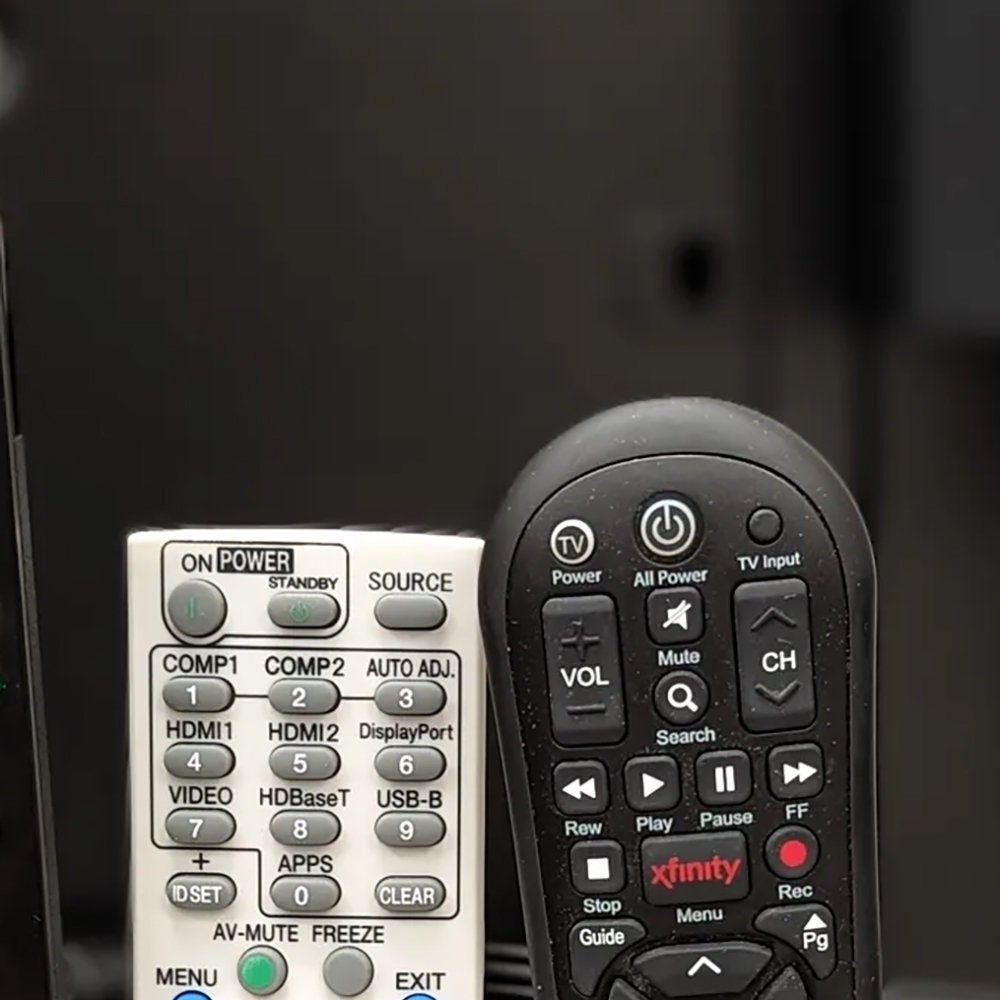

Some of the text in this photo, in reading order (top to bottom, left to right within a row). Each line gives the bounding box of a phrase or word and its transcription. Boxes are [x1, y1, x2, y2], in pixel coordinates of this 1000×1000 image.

[559, 535, 585, 554] TV
[181, 554, 212, 573] ON
[220, 550, 291, 573] POWER
[737, 553, 801, 571] TV Input
[268, 577, 338, 590] STANDBY
[368, 573, 453, 592] SOURCE
[552, 570, 602, 585] Power
[634, 568, 708, 587] All Power
[163, 654, 237, 675] COMP1
[264, 657, 345, 677] COMP2
[658, 650, 700, 666] Mute
[762, 650, 796, 672] CH
[366, 658, 455, 679] AUTO ADJ.
[561, 666, 609, 687] VOL
[186, 685, 197, 705] 1
[292, 687, 306, 708] 2
[399, 688, 413, 709] 3
[167, 721, 233, 741] HDMI1
[269, 723, 339, 743] HDMI2
[359, 723, 453, 745] DisplayPort
[656, 728, 716, 746] Search
[187, 752, 201, 772] 4
[293, 753, 307, 773] 5
[399, 754, 414, 775] 6
[169, 786, 233, 806] VIDEO
[259, 788, 351, 807] HDBaseT
[377, 790, 442, 808] USB-B
[700, 810, 753, 828] Pause
[786, 803, 809, 819] FF
[189, 819, 203, 839] 7
[293, 818, 308, 839] 8
[400, 819, 414, 841] 9
[565, 820, 602, 836] Rew
[636, 817, 673, 834] Play
[278, 855, 333, 873] APPS
[651, 856, 741, 889] xfinity
[294, 886, 308, 906] 0
[379, 886, 435, 905] CLEAR
[778, 885, 813, 900] Rec
[583, 899, 622, 915] Stop
[676, 908, 723, 924] Menu
[213, 924, 299, 943] AV-MUTE
[312, 925, 385, 944] FREEZE
[579, 930, 625, 946] Guide
[803, 932, 829, 951] Pg
[156, 968, 218, 987] MENU
[395, 973, 447, 992] EXIT
